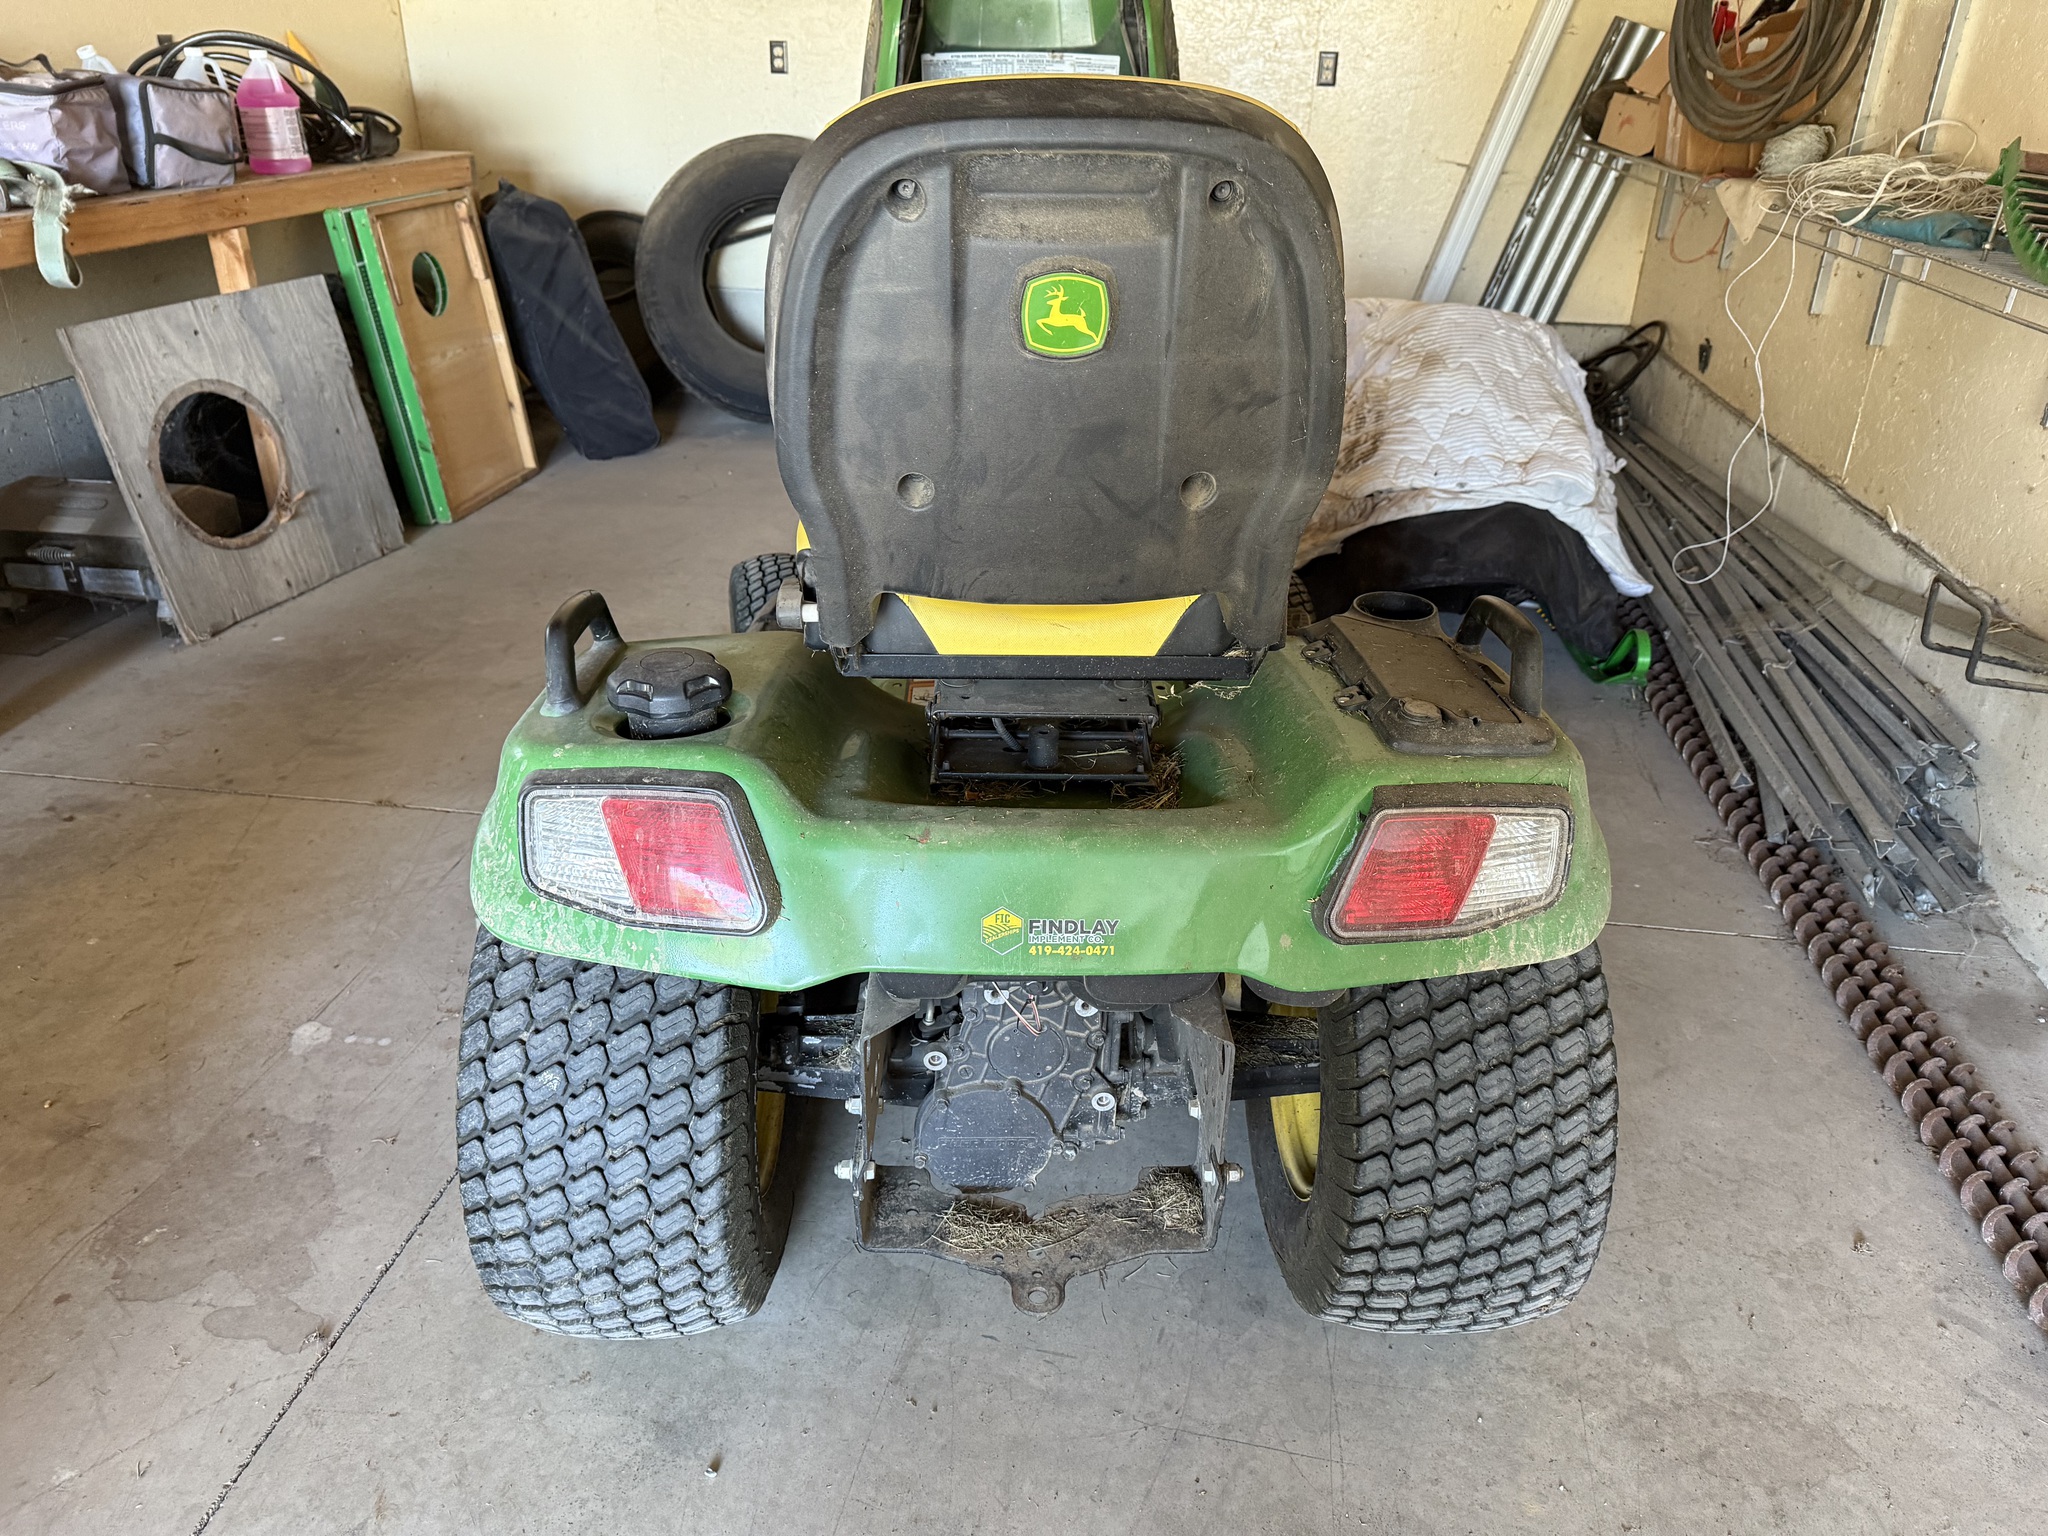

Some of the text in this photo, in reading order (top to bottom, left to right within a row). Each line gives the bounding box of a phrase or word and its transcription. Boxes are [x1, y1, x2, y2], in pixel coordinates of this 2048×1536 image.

[1028, 919, 1119, 935] FINDLAY
[985, 929, 1019, 944] DEALERSHIPS
[1028, 935, 1104, 944] IMPLEMENT CO.
[1028, 945, 1115, 956] 419-424-0471
